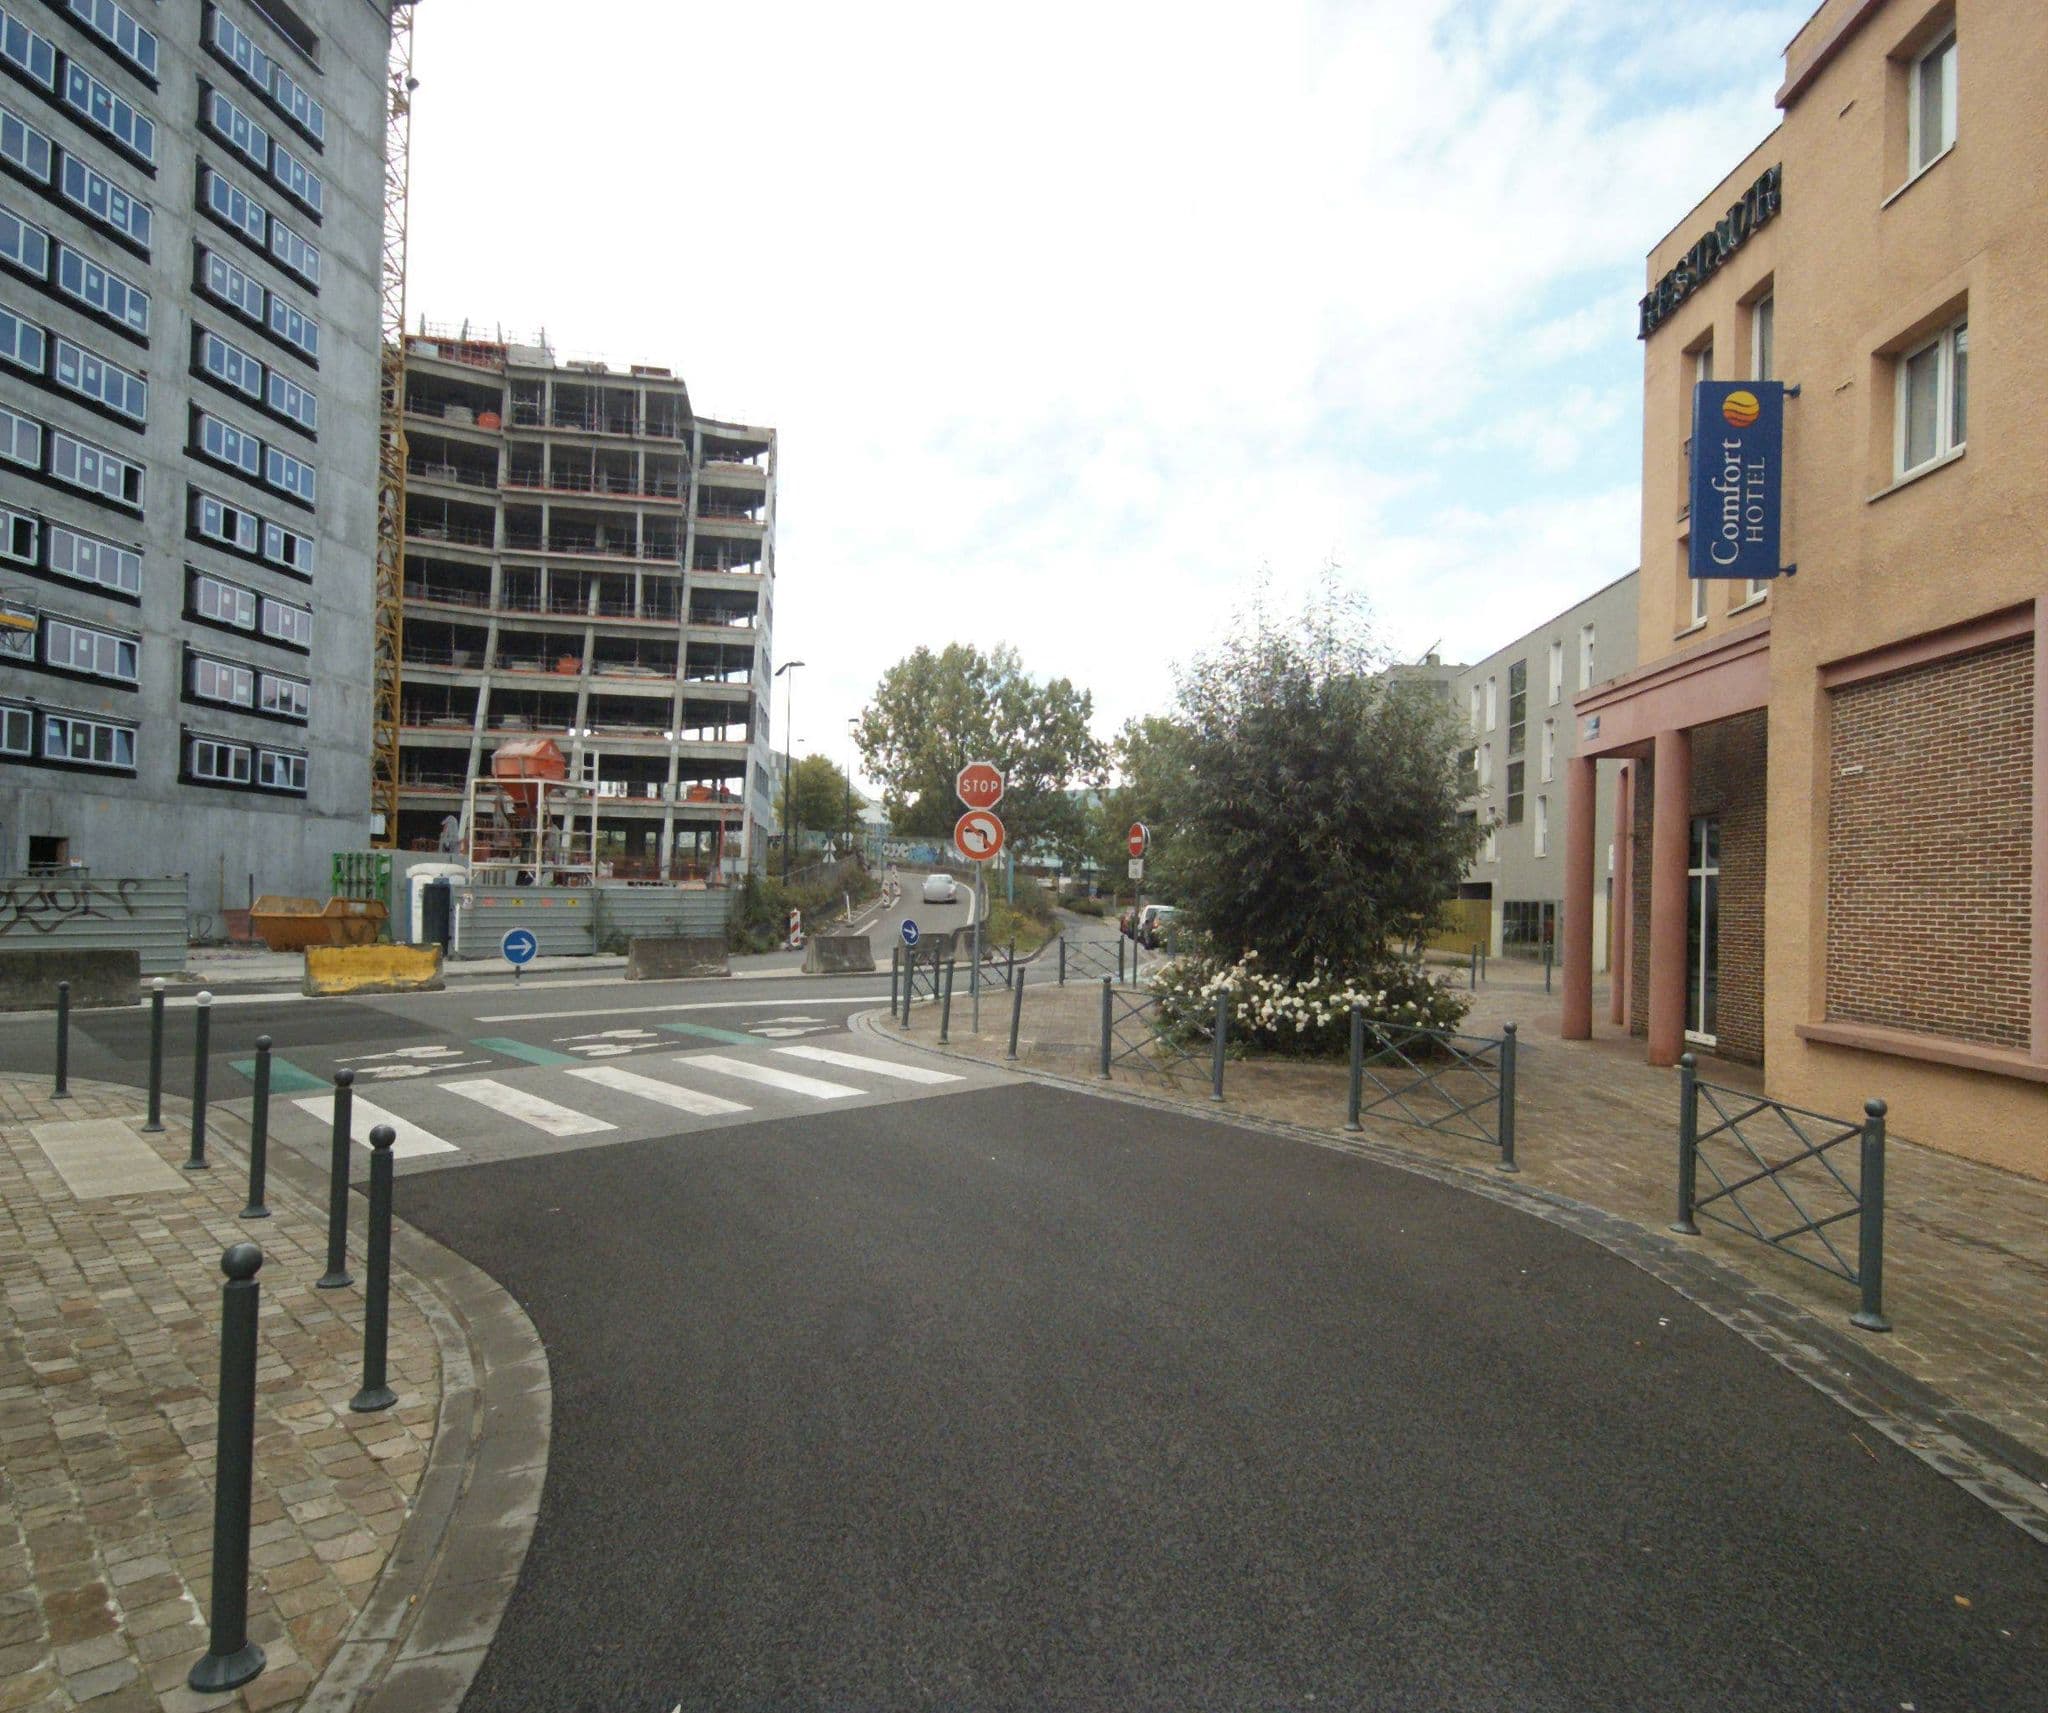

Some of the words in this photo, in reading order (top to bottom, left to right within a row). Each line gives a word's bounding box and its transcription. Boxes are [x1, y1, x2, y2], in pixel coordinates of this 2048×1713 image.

[1711, 438, 1742, 565] Comfort
[1745, 457, 1765, 542] HOTEL
[963, 779, 998, 792] STOP
